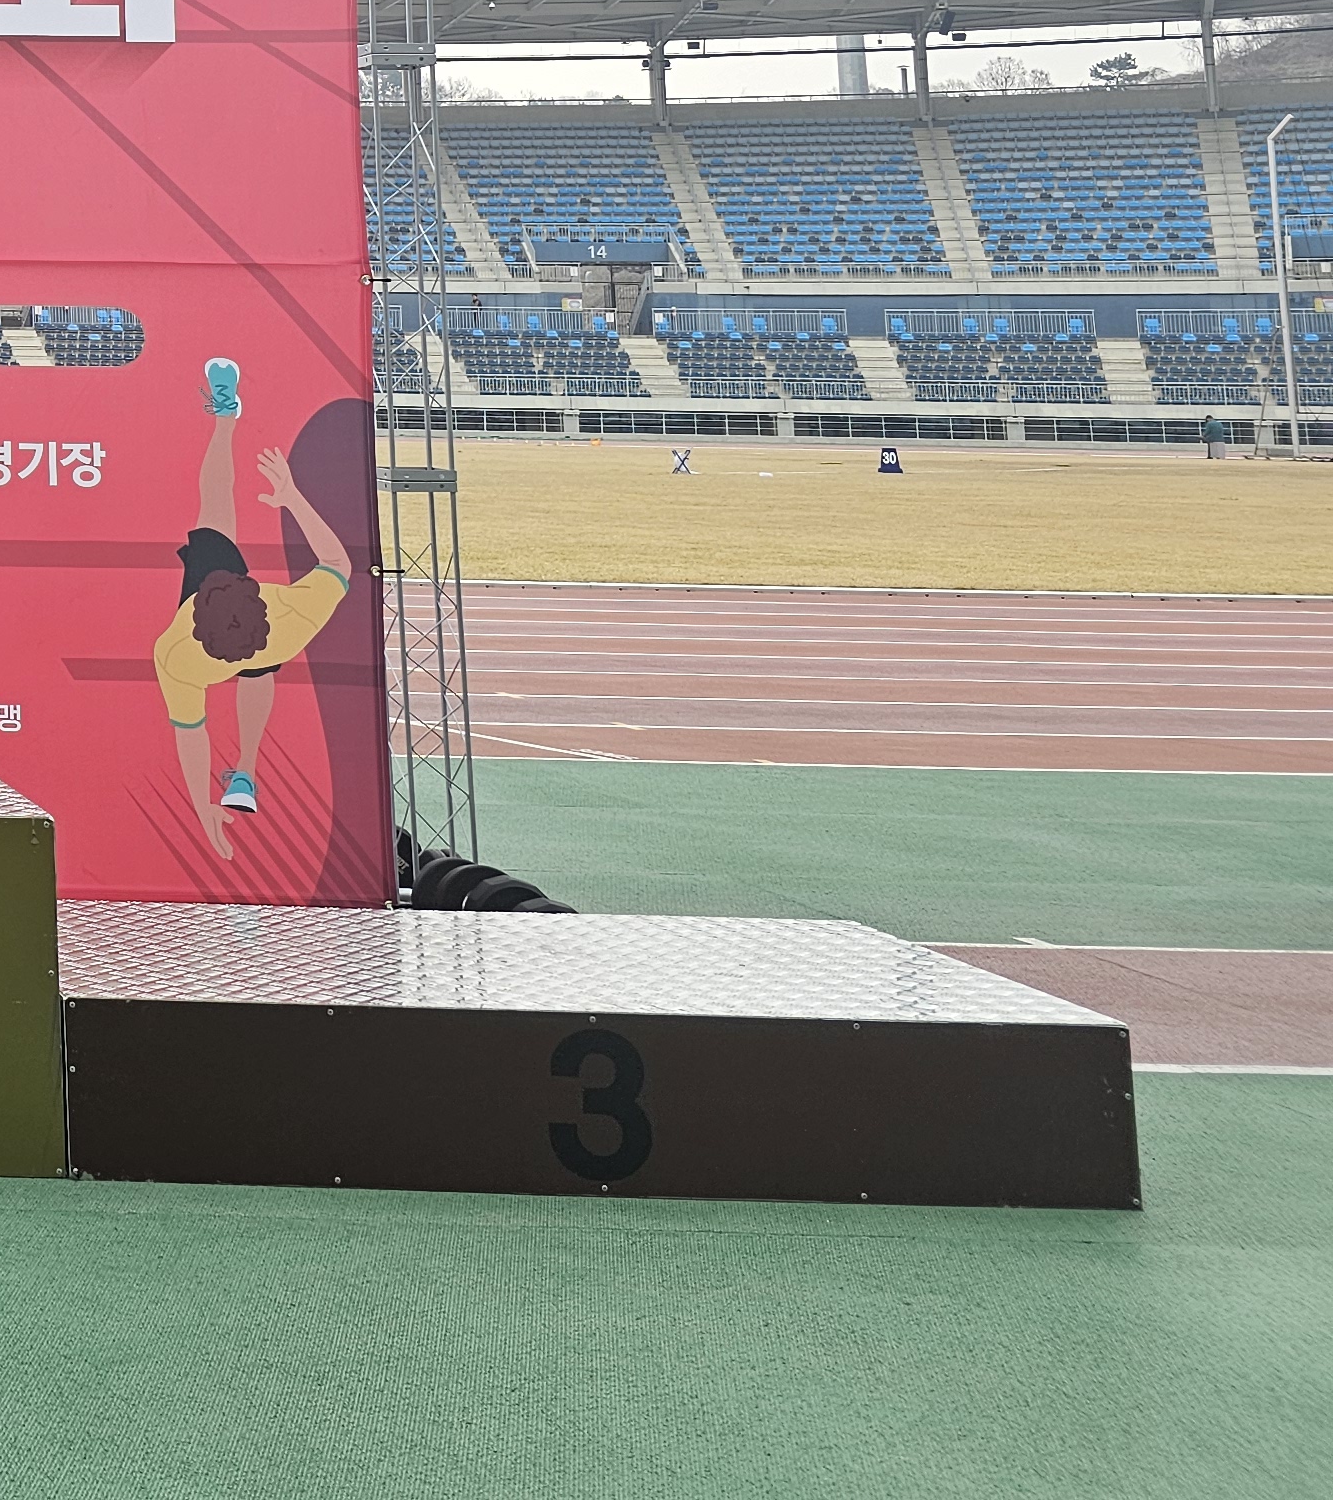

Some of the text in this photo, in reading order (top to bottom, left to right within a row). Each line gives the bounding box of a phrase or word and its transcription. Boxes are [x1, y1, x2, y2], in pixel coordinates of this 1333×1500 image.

[587, 245, 608, 259] 14
[882, 451, 897, 465] 30
[548, 1028, 653, 1182] 3
